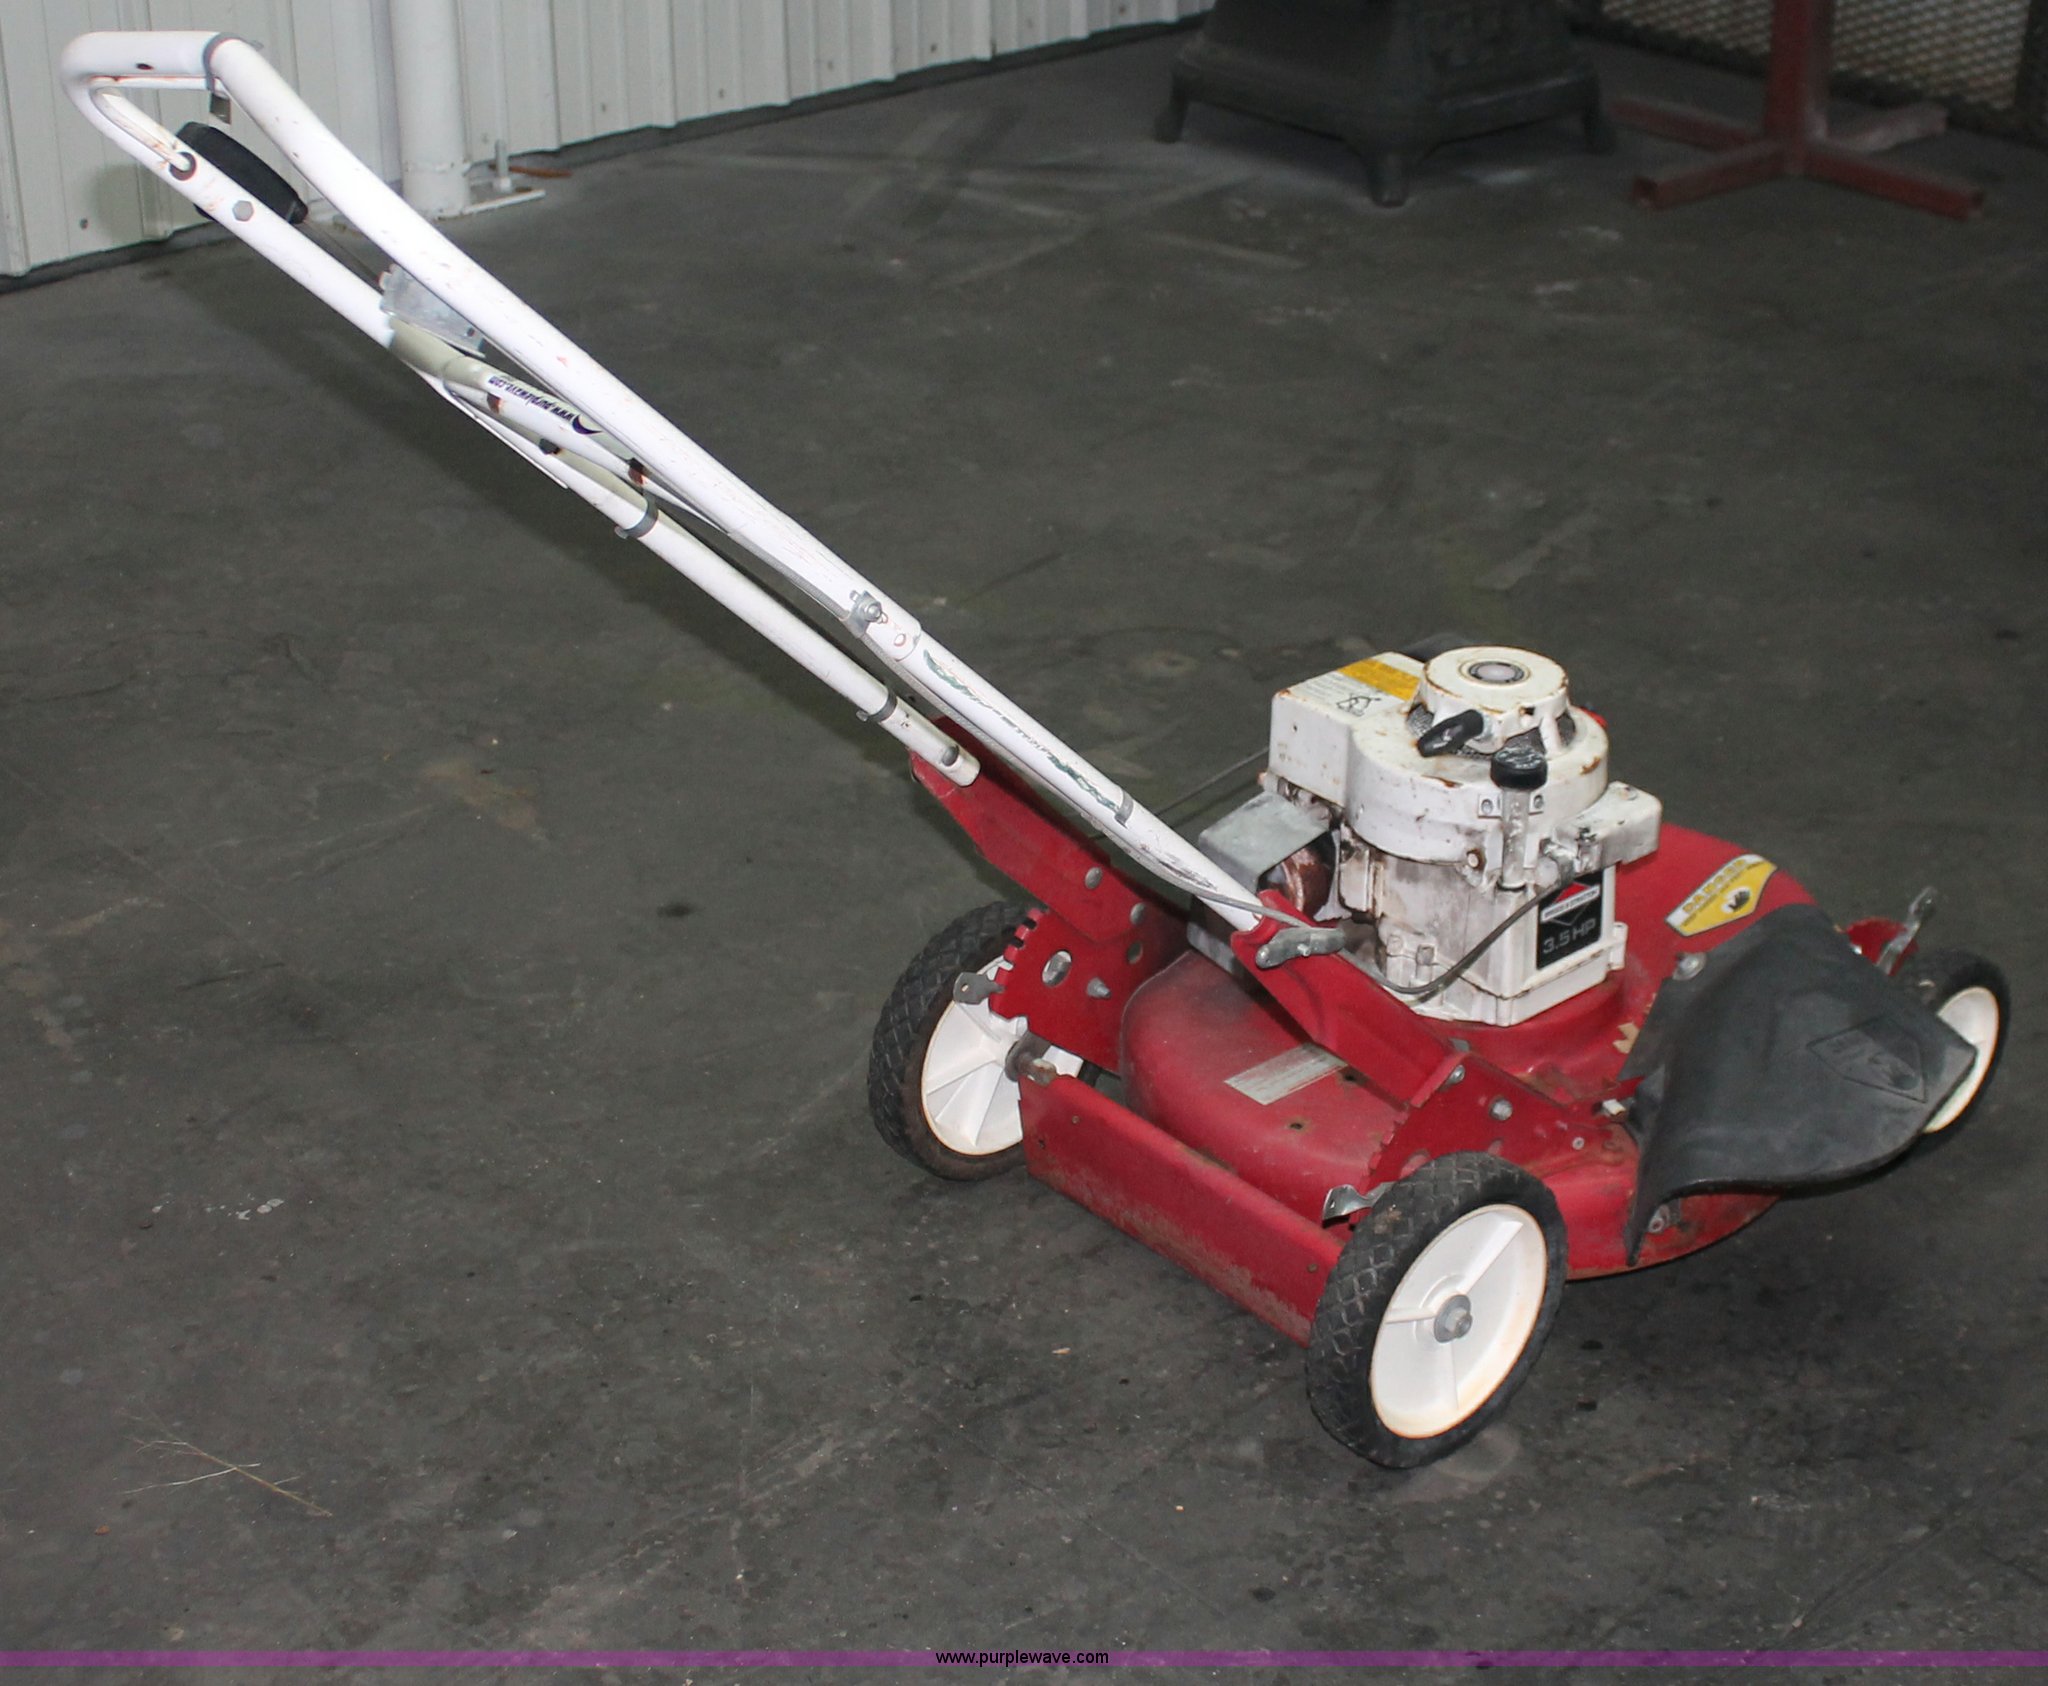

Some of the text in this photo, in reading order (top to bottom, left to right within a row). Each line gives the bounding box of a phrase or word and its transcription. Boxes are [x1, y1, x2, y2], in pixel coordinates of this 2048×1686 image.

[488, 376, 575, 421] www.purplewave.com
[1543, 918, 1596, 953] 3.5 HP
